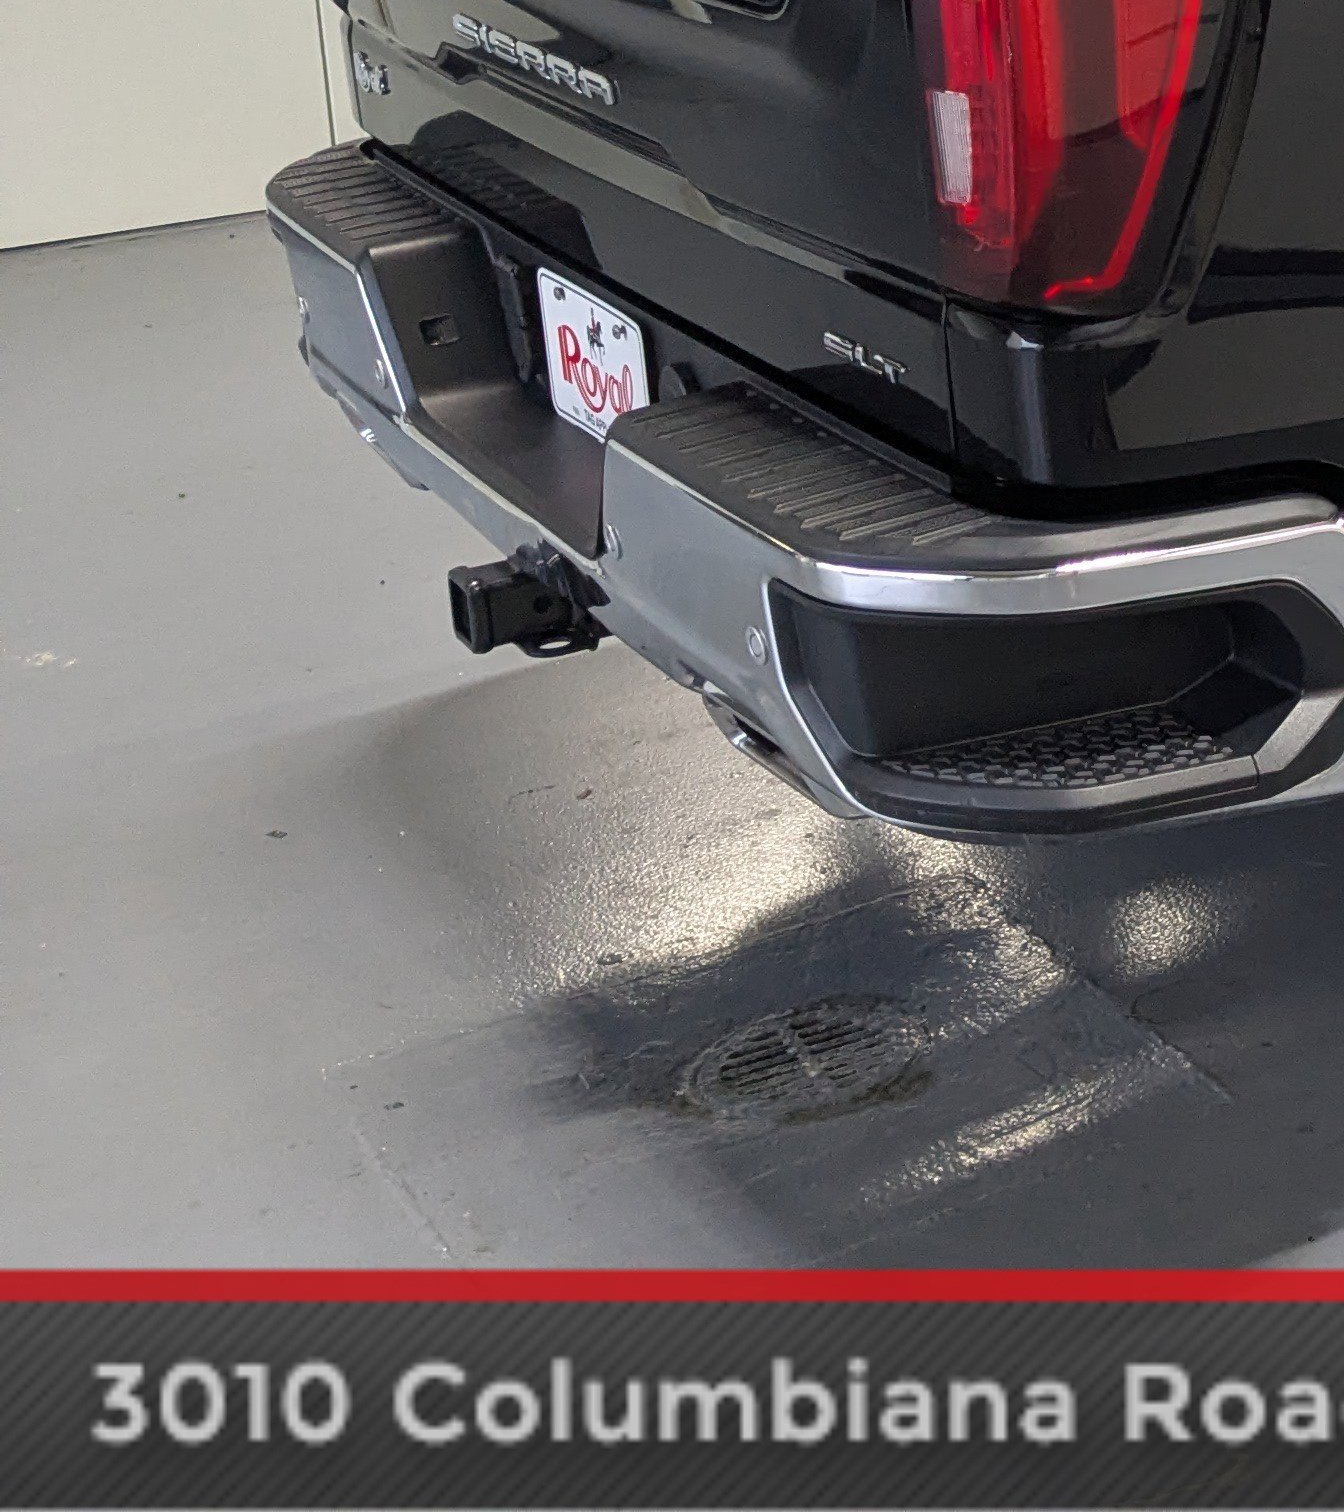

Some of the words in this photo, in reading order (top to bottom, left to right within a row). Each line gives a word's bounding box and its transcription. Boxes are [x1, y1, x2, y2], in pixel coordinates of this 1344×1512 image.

[452, 13, 621, 107] SIERRA
[557, 324, 634, 415] Royal
[823, 331, 911, 385] SLT
